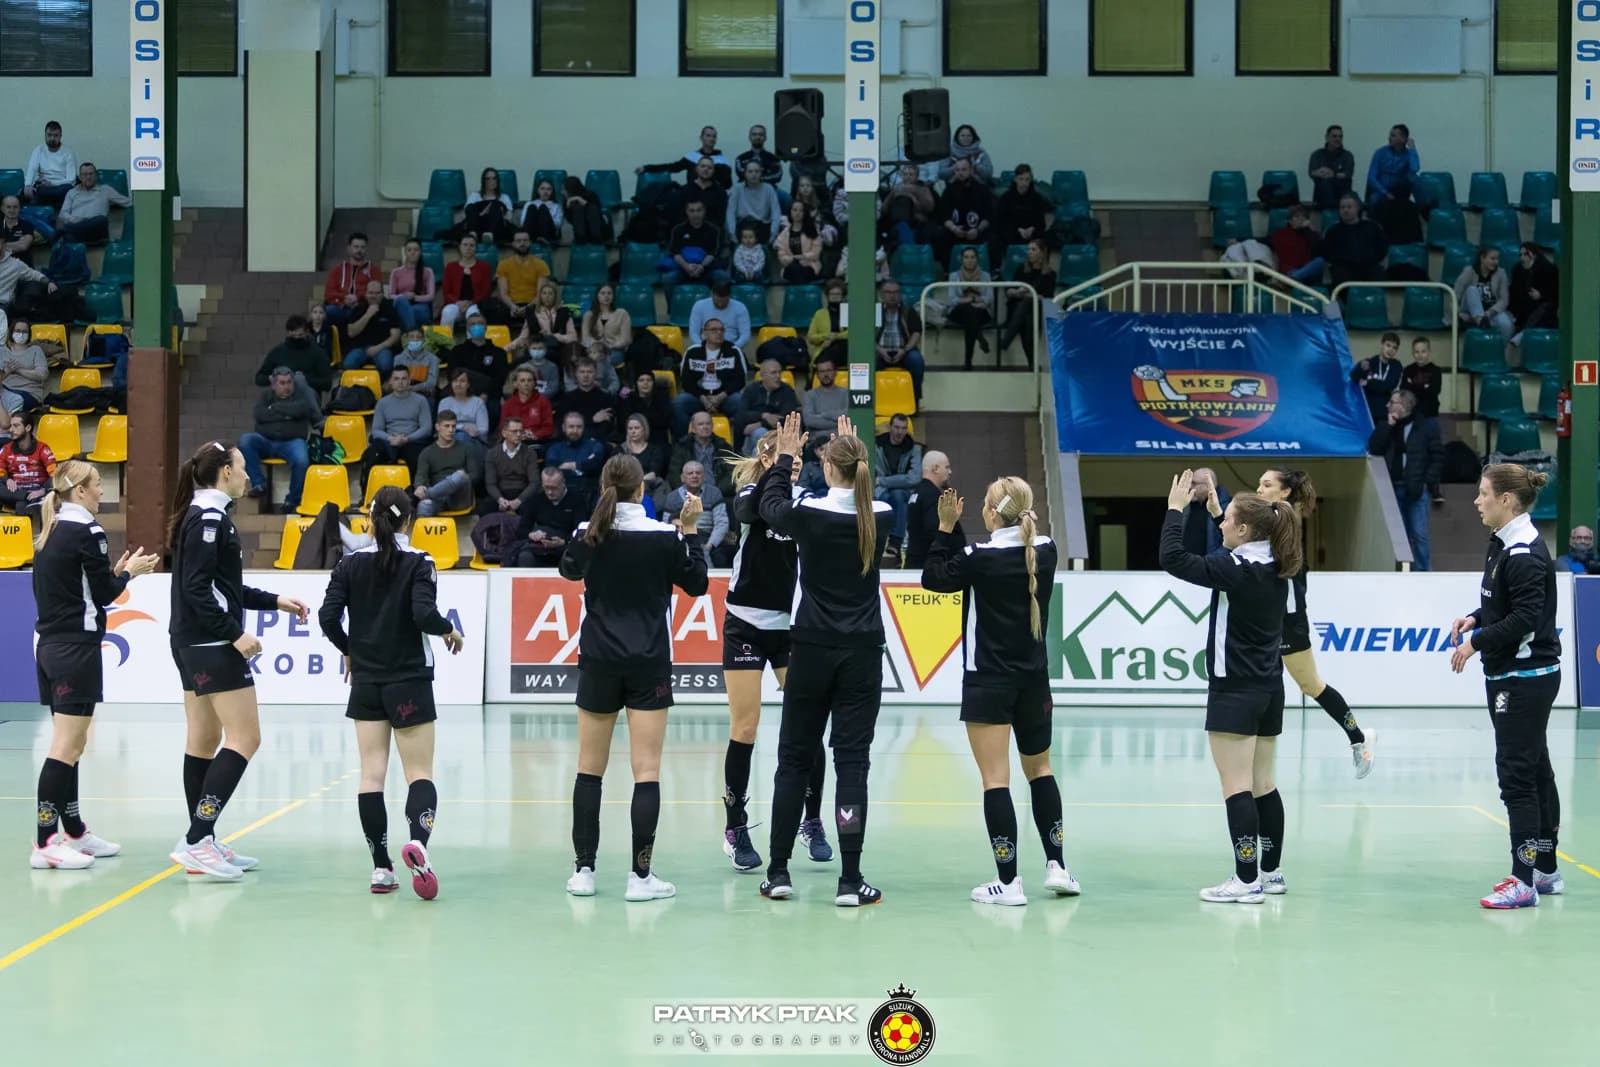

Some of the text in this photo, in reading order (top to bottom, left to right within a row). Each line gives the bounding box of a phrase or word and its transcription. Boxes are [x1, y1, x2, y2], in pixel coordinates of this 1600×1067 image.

[1148, 336, 1245, 351] WYJŚCIE A
[1180, 378, 1225, 388] MKS
[852, 394, 871, 405] VIP
[1139, 401, 1276, 411] PIOTRKOWIANIN
[1135, 440, 1301, 450] SILNI RAZEM
[3, 526, 21, 535] VIP
[424, 525, 448, 535] VIP
[896, 594, 948, 606] "PEUK"
[525, 674, 567, 688] WAY
